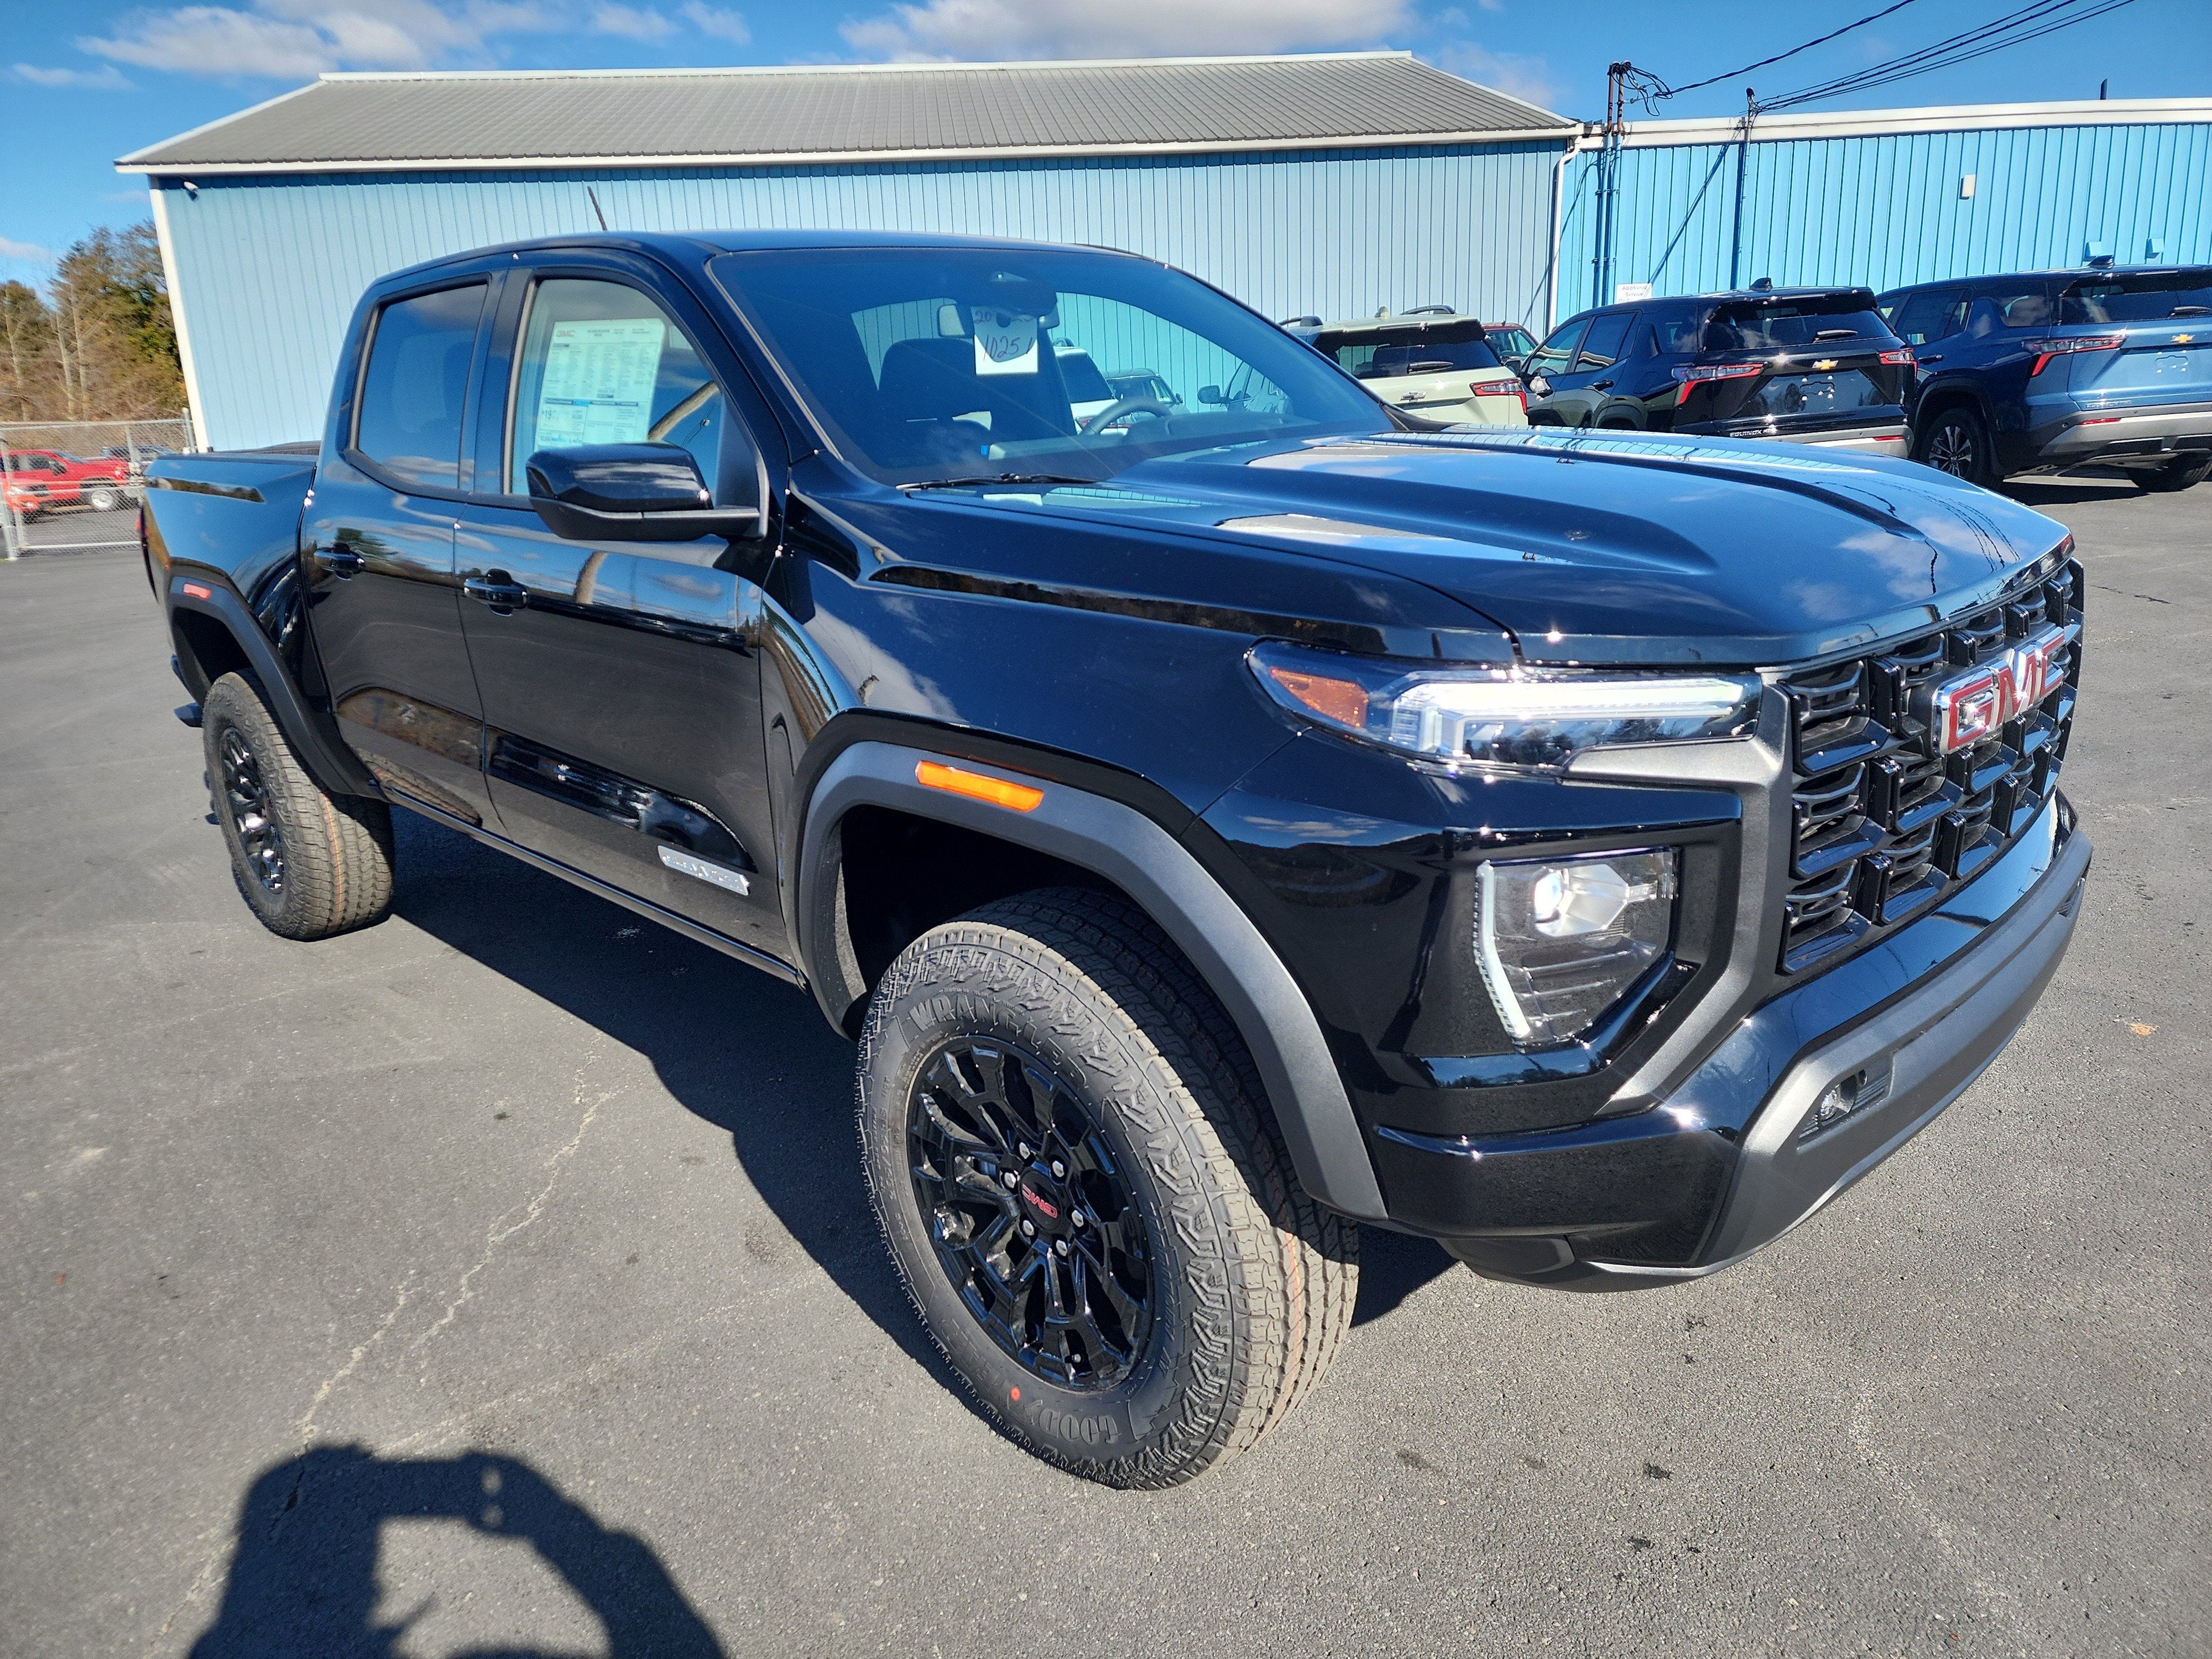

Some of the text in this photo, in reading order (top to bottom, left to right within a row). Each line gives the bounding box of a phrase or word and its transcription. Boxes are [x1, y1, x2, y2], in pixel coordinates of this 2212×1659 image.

[1730, 429, 1762, 437] EQUINOX
[1940, 627, 2066, 754] GMC
[909, 995, 1089, 1088] WRANGLER
[1022, 1183, 1057, 1218] GMC
